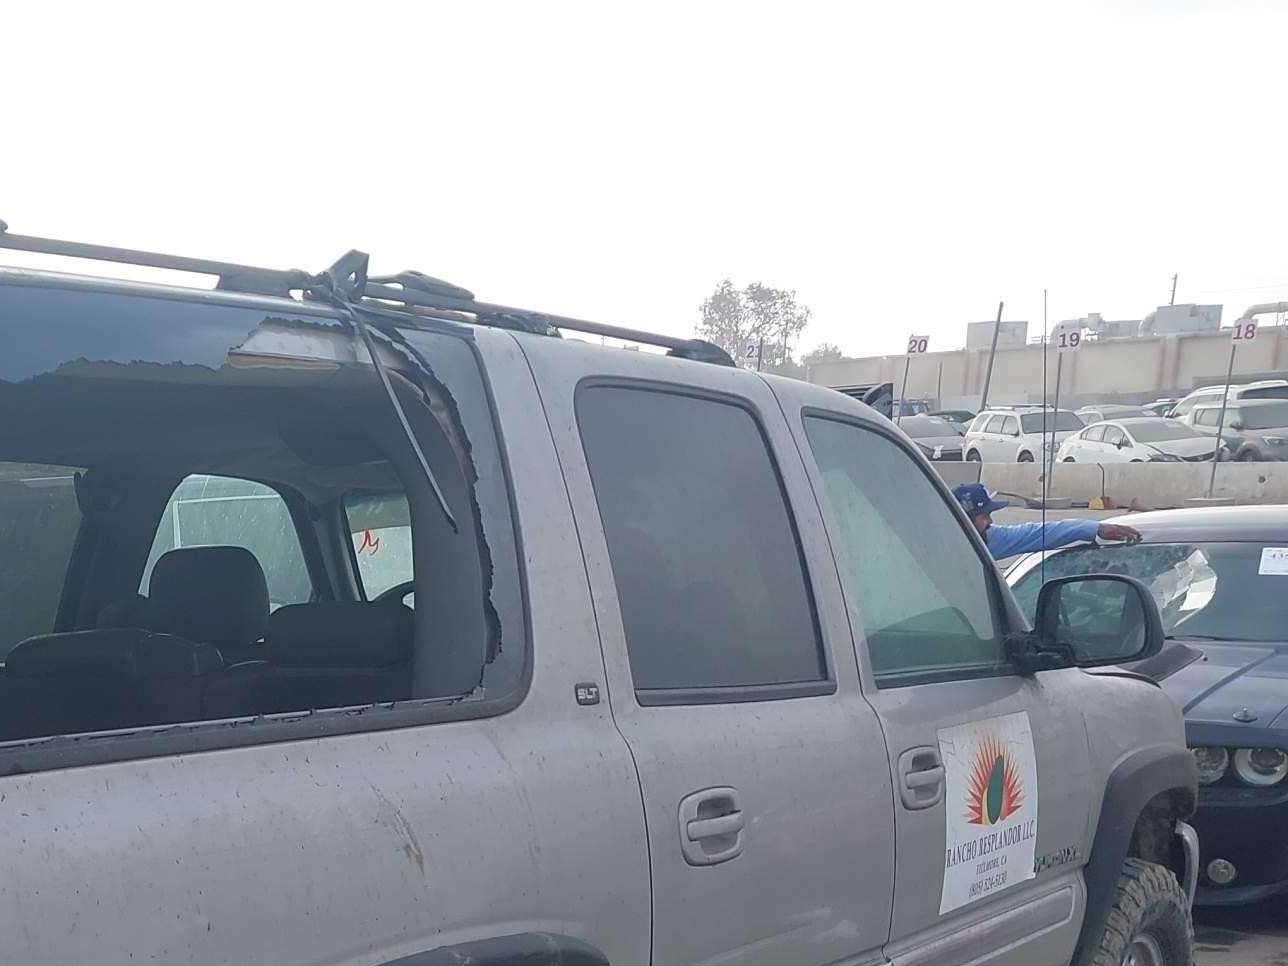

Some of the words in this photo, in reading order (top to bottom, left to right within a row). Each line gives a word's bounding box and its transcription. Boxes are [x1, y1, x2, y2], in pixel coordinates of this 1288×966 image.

[1232, 323, 1256, 340] 18
[908, 339, 928, 353] 20
[1058, 332, 1080, 348] 19
[577, 687, 598, 700] SLT
[946, 839, 977, 868] RANCHO
[978, 824, 1022, 857] RESPLANDOR
